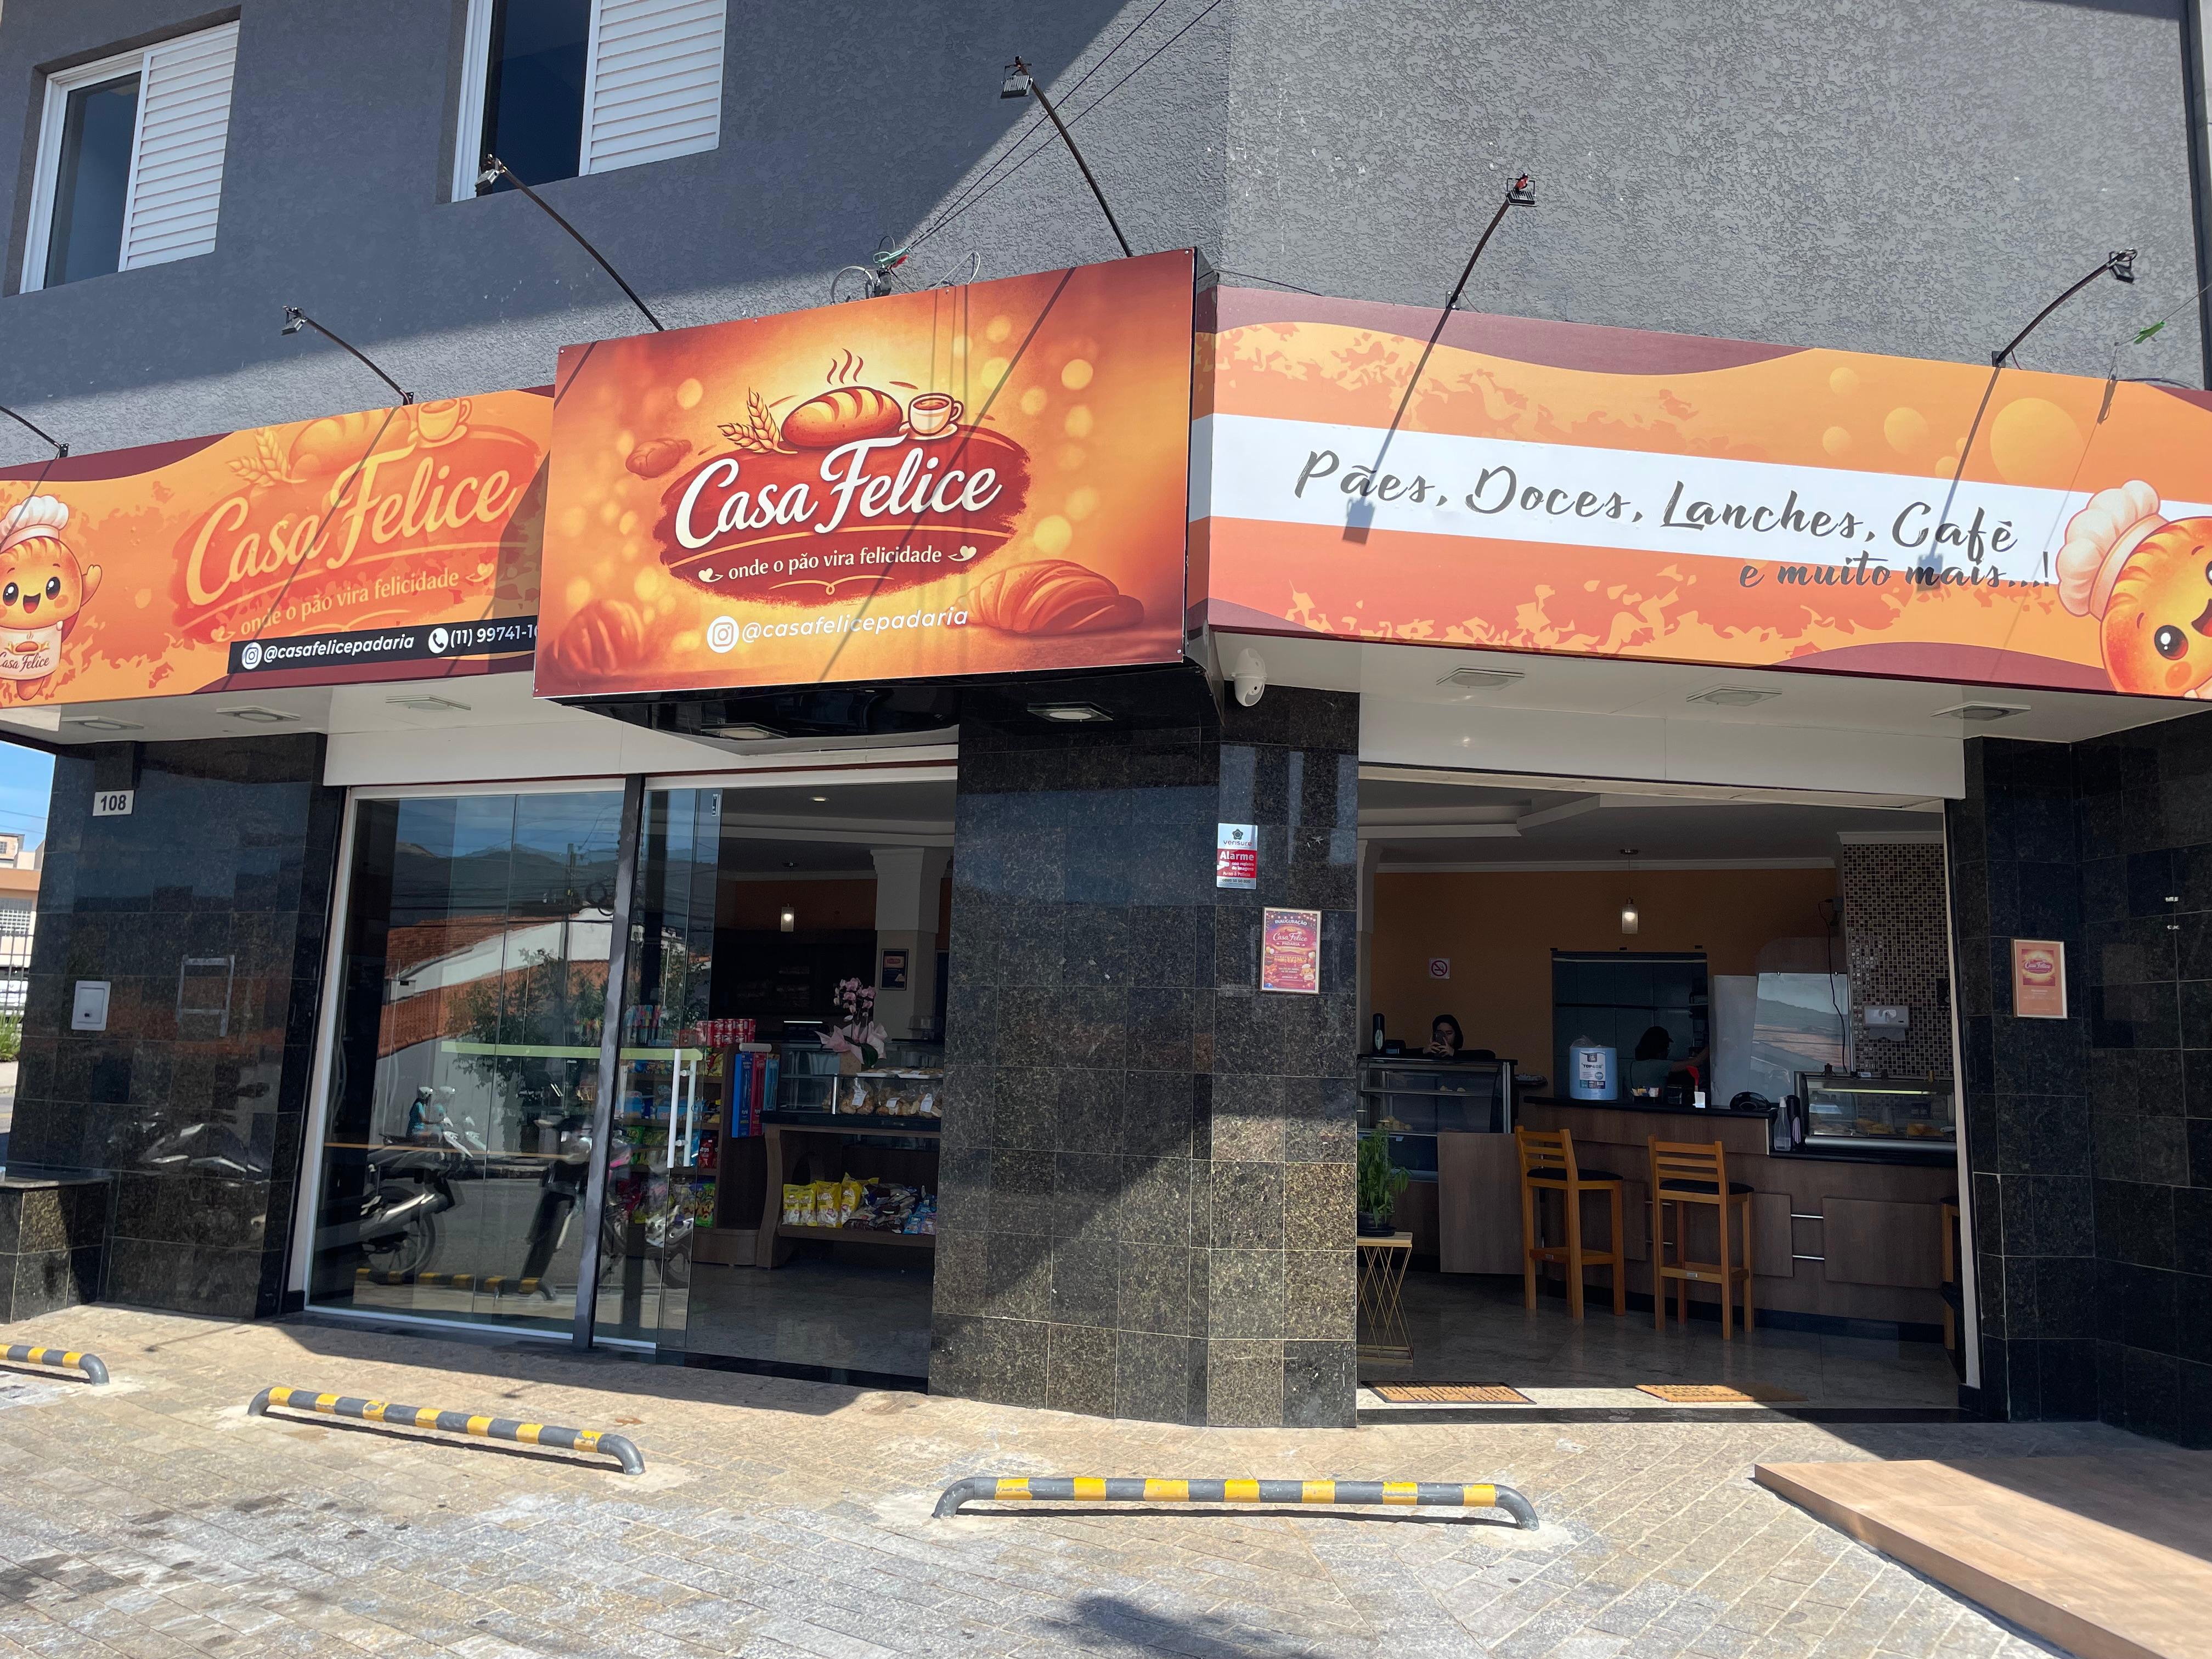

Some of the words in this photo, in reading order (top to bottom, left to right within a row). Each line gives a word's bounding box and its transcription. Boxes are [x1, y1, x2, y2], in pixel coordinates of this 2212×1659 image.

[674, 458, 817, 549] Casa
[815, 436, 1002, 534] Felice
[1294, 450, 1448, 507] Pães,
[1465, 465, 1644, 524] Doces,
[1660, 480, 1876, 543] Lanches,
[186, 496, 329, 607] Casa
[328, 444, 516, 568] Felice
[729, 560, 769, 580] onde
[774, 561, 783, 572] o
[789, 552, 819, 575] pão
[823, 549, 854, 567] vira
[860, 545, 941, 565] felicidade
[1739, 566, 1764, 588] e
[1777, 551, 1892, 588] muito
[241, 609, 281, 636] onde
[286, 606, 296, 620] o
[301, 595, 332, 622] pão
[336, 586, 369, 607] vira
[375, 567, 459, 600] felicidade
[450, 629, 473, 648] (11)
[742, 607, 968, 644] @casafelicepadaria
[19, 652, 49, 673] Felice
[263, 635, 414, 664] @casafelicepadaria
[100, 794, 126, 811] 108
[1220, 851, 1254, 861] Alarme
[1273, 932, 1289, 941] Casa
[1288, 932, 1308, 941] Felice
